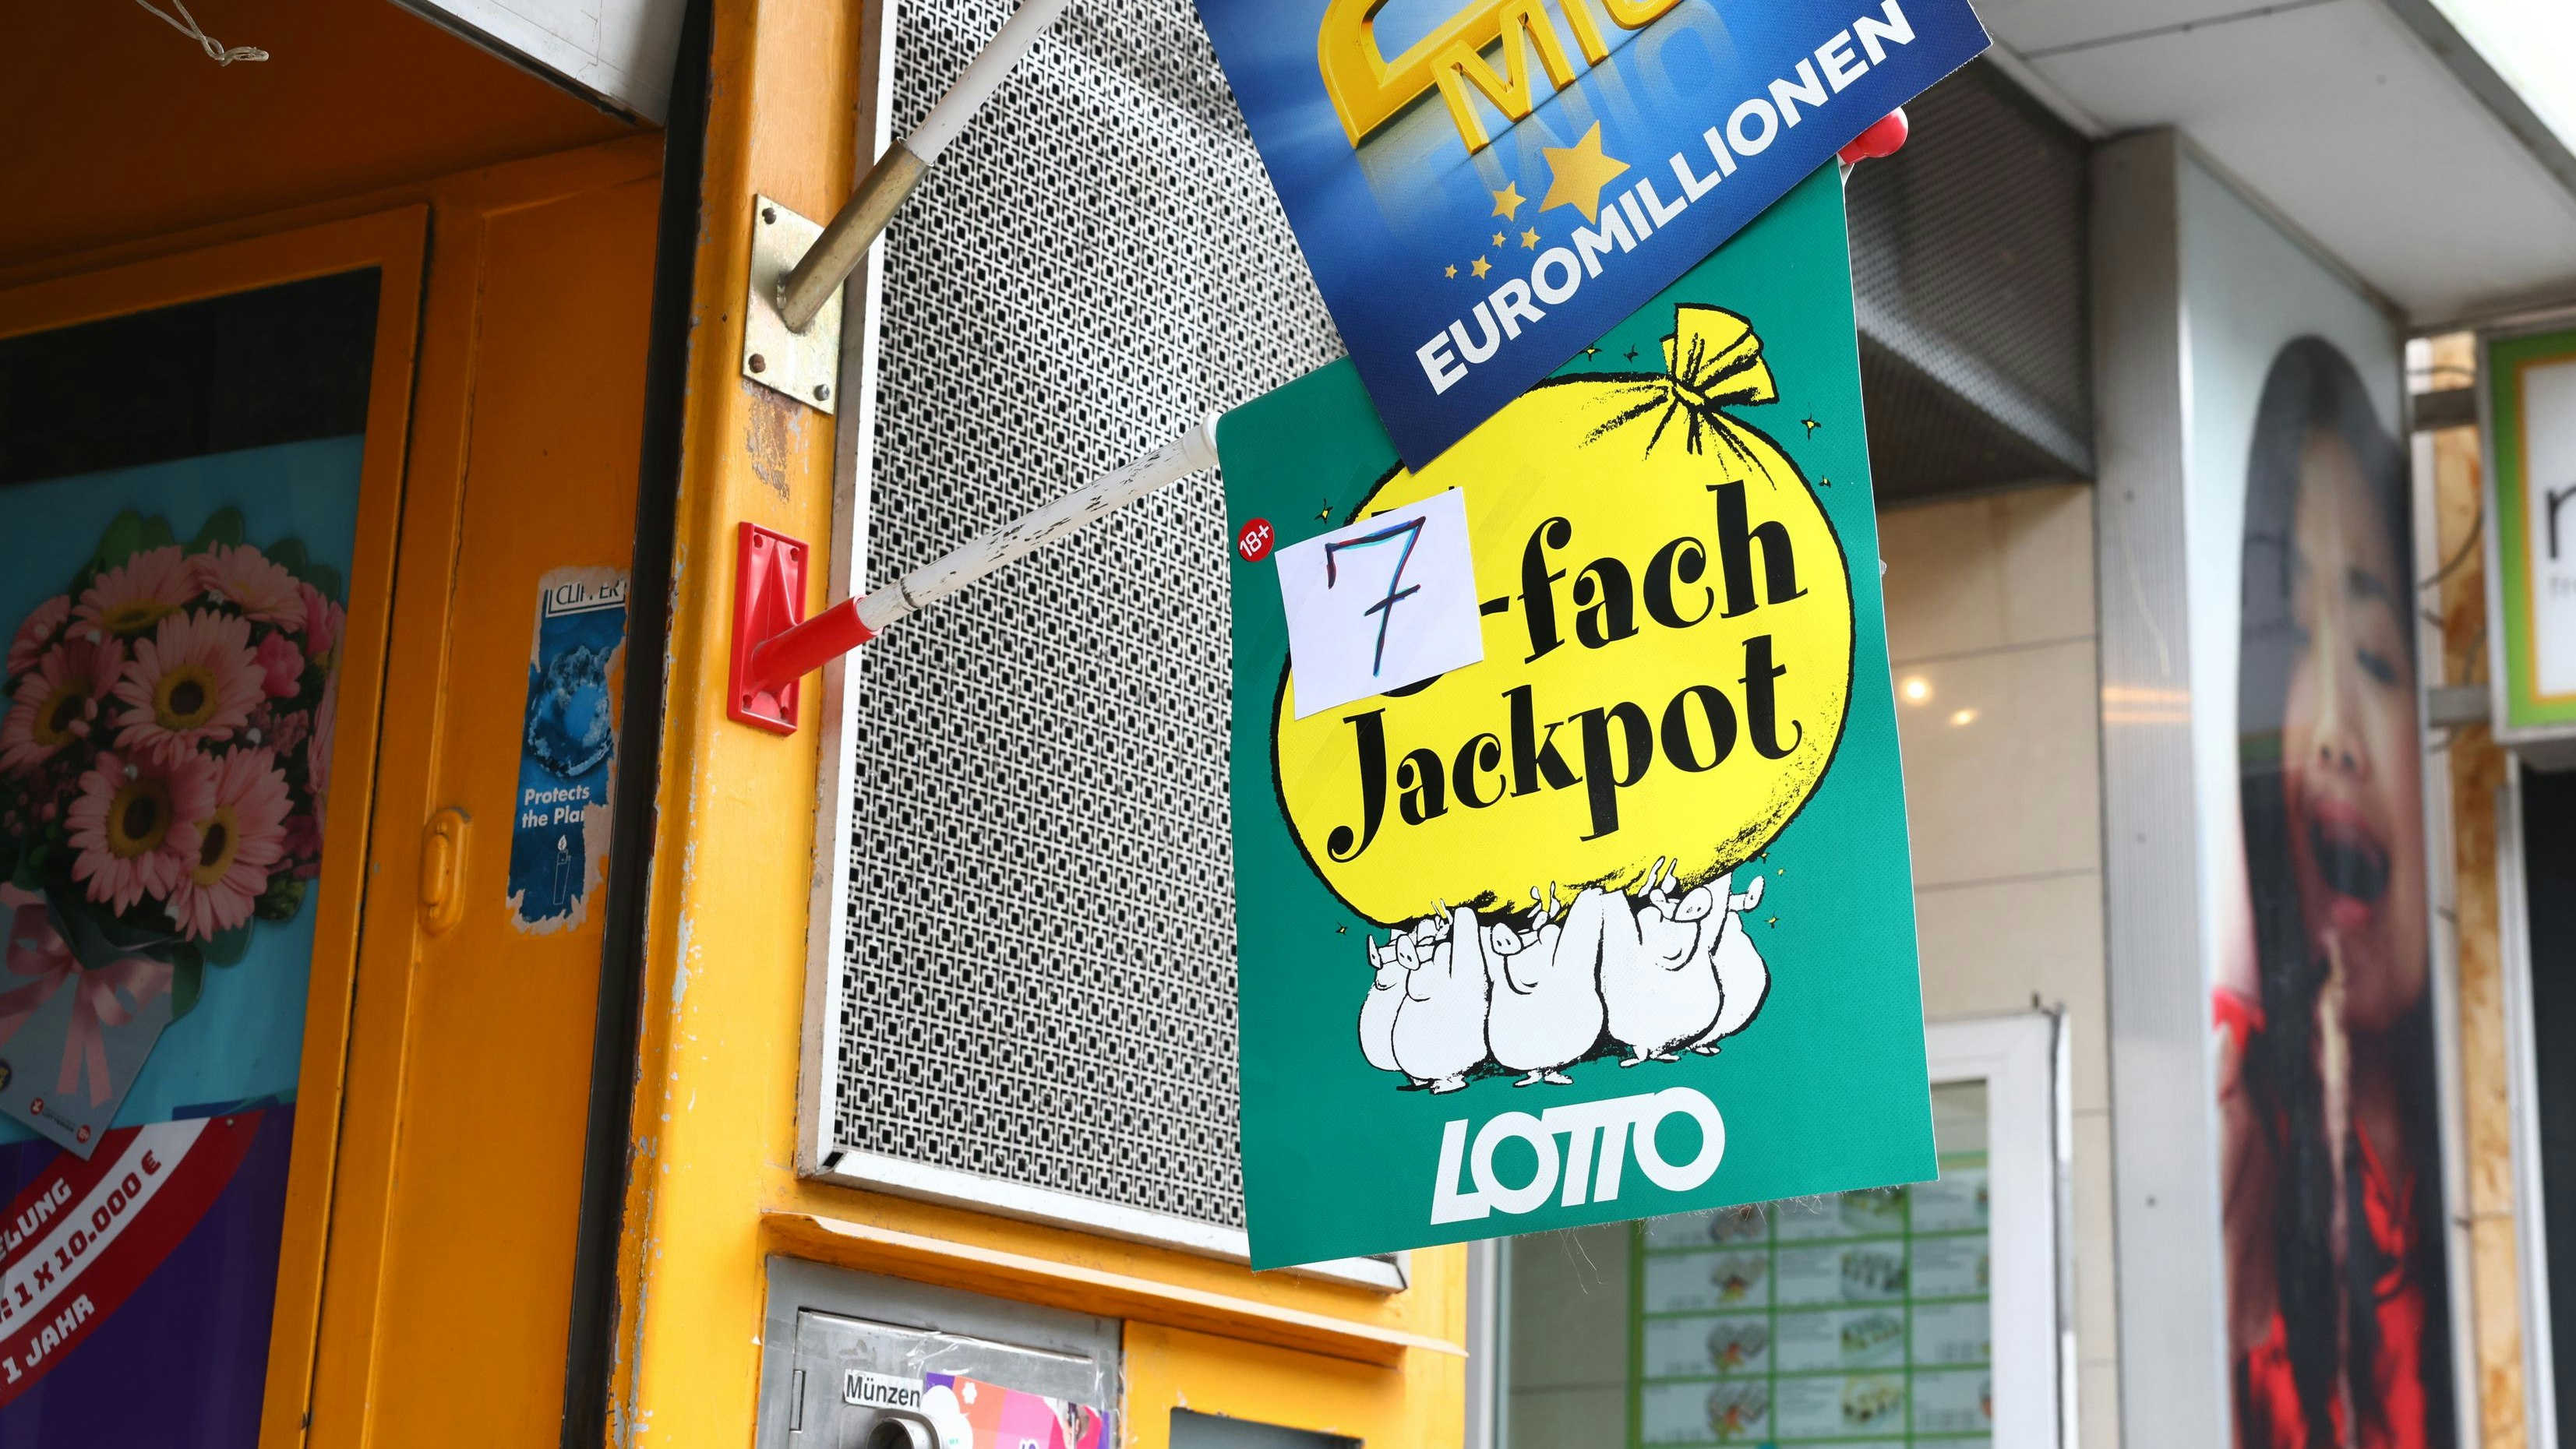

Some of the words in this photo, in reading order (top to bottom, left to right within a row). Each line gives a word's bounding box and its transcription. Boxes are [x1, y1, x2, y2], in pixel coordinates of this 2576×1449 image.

[1414, 0, 1917, 396] EUROMILLIONEN
[1239, 524, 1270, 558] 18+
[556, 580, 620, 605] CLIER
[1325, 516, 1426, 678] 7
[1326, 634, 1803, 864] Jackpot
[522, 809, 548, 829] the
[524, 784, 591, 806] Protects
[1430, 1087, 1725, 1225] LOTTO
[14, 1282, 34, 1309] 1
[55, 1172, 142, 1272] 10.000
[140, 1149, 161, 1176] €
[3, 1356, 23, 1384] 1
[26, 1293, 95, 1368] JAHR
[846, 1374, 922, 1408] Münzen
